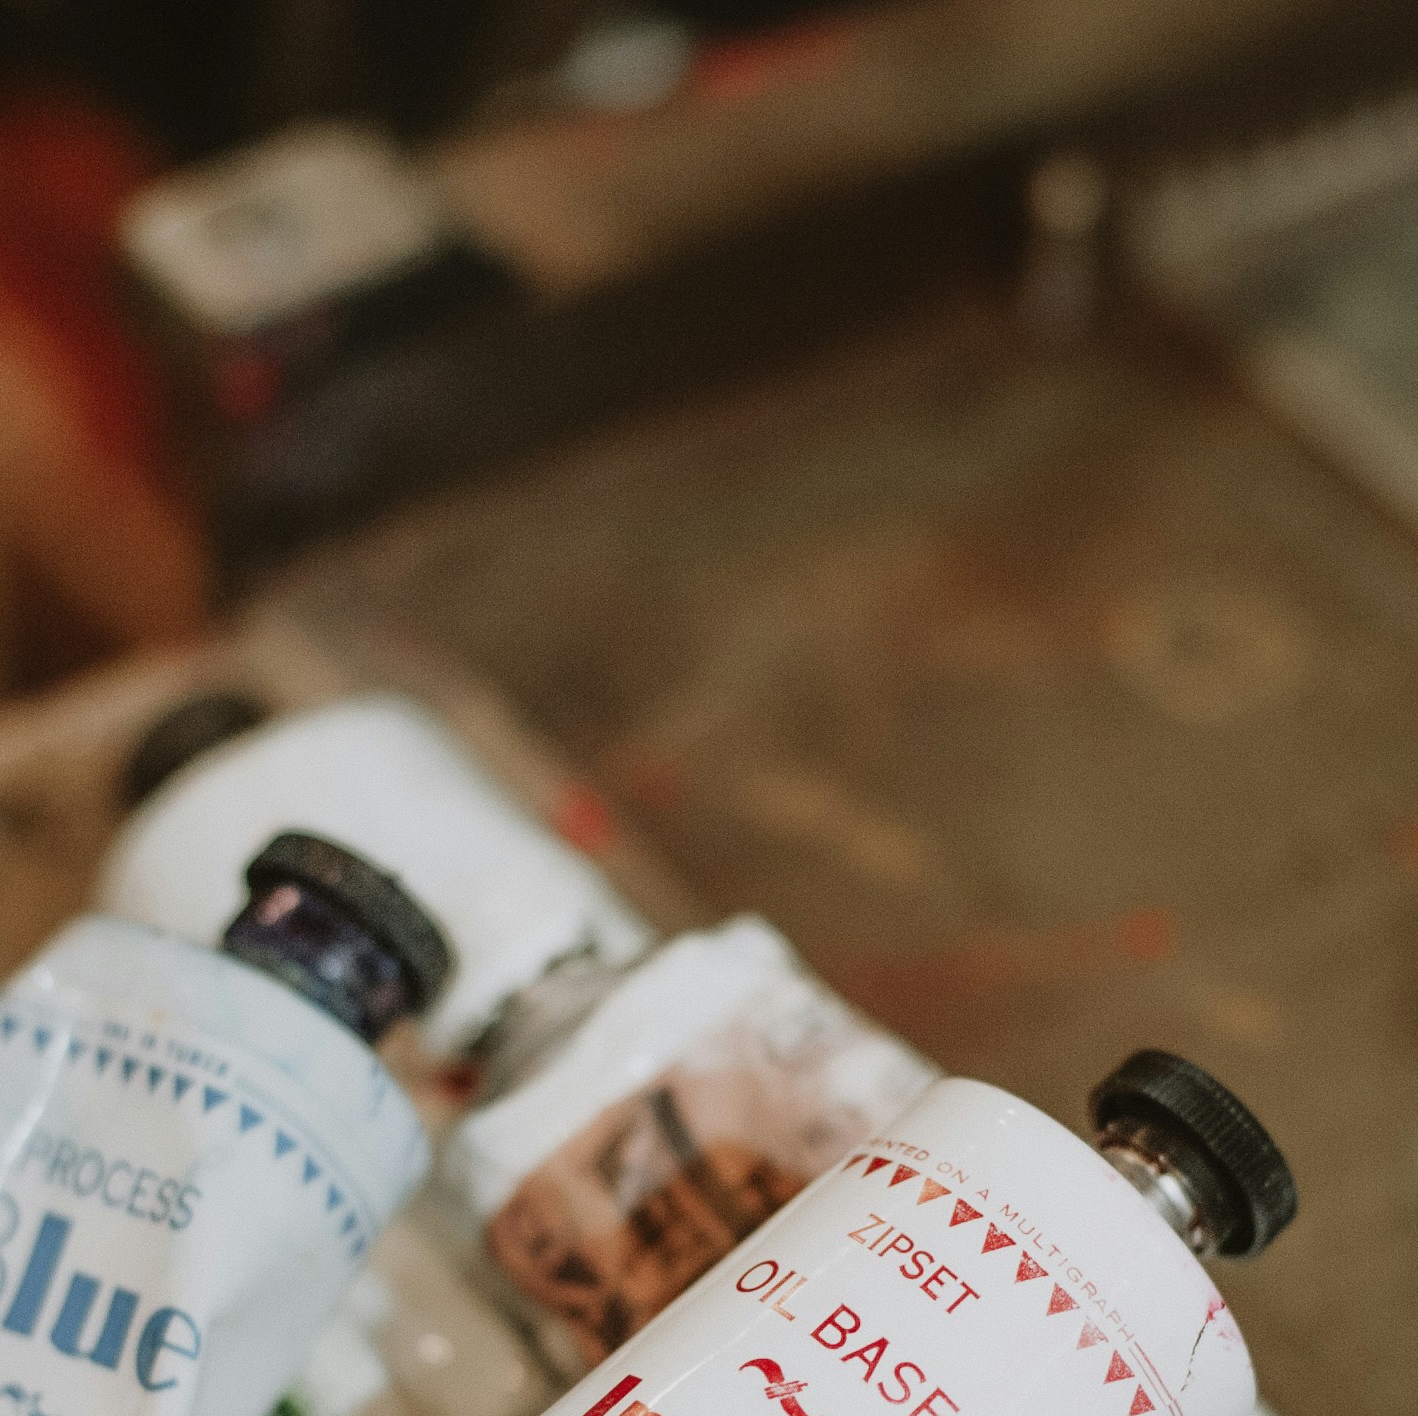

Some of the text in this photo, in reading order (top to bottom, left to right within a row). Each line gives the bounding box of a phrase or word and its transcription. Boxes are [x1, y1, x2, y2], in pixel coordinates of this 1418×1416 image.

[19, 1128, 203, 1231] PROCESS
[735, 1259, 808, 1322] OIL
[846, 1212, 981, 1315] ZIPSET
[936, 1161, 970, 1184] ON
[974, 1187, 991, 1202] A
[998, 1203, 1137, 1343] MULTIGRAPH
